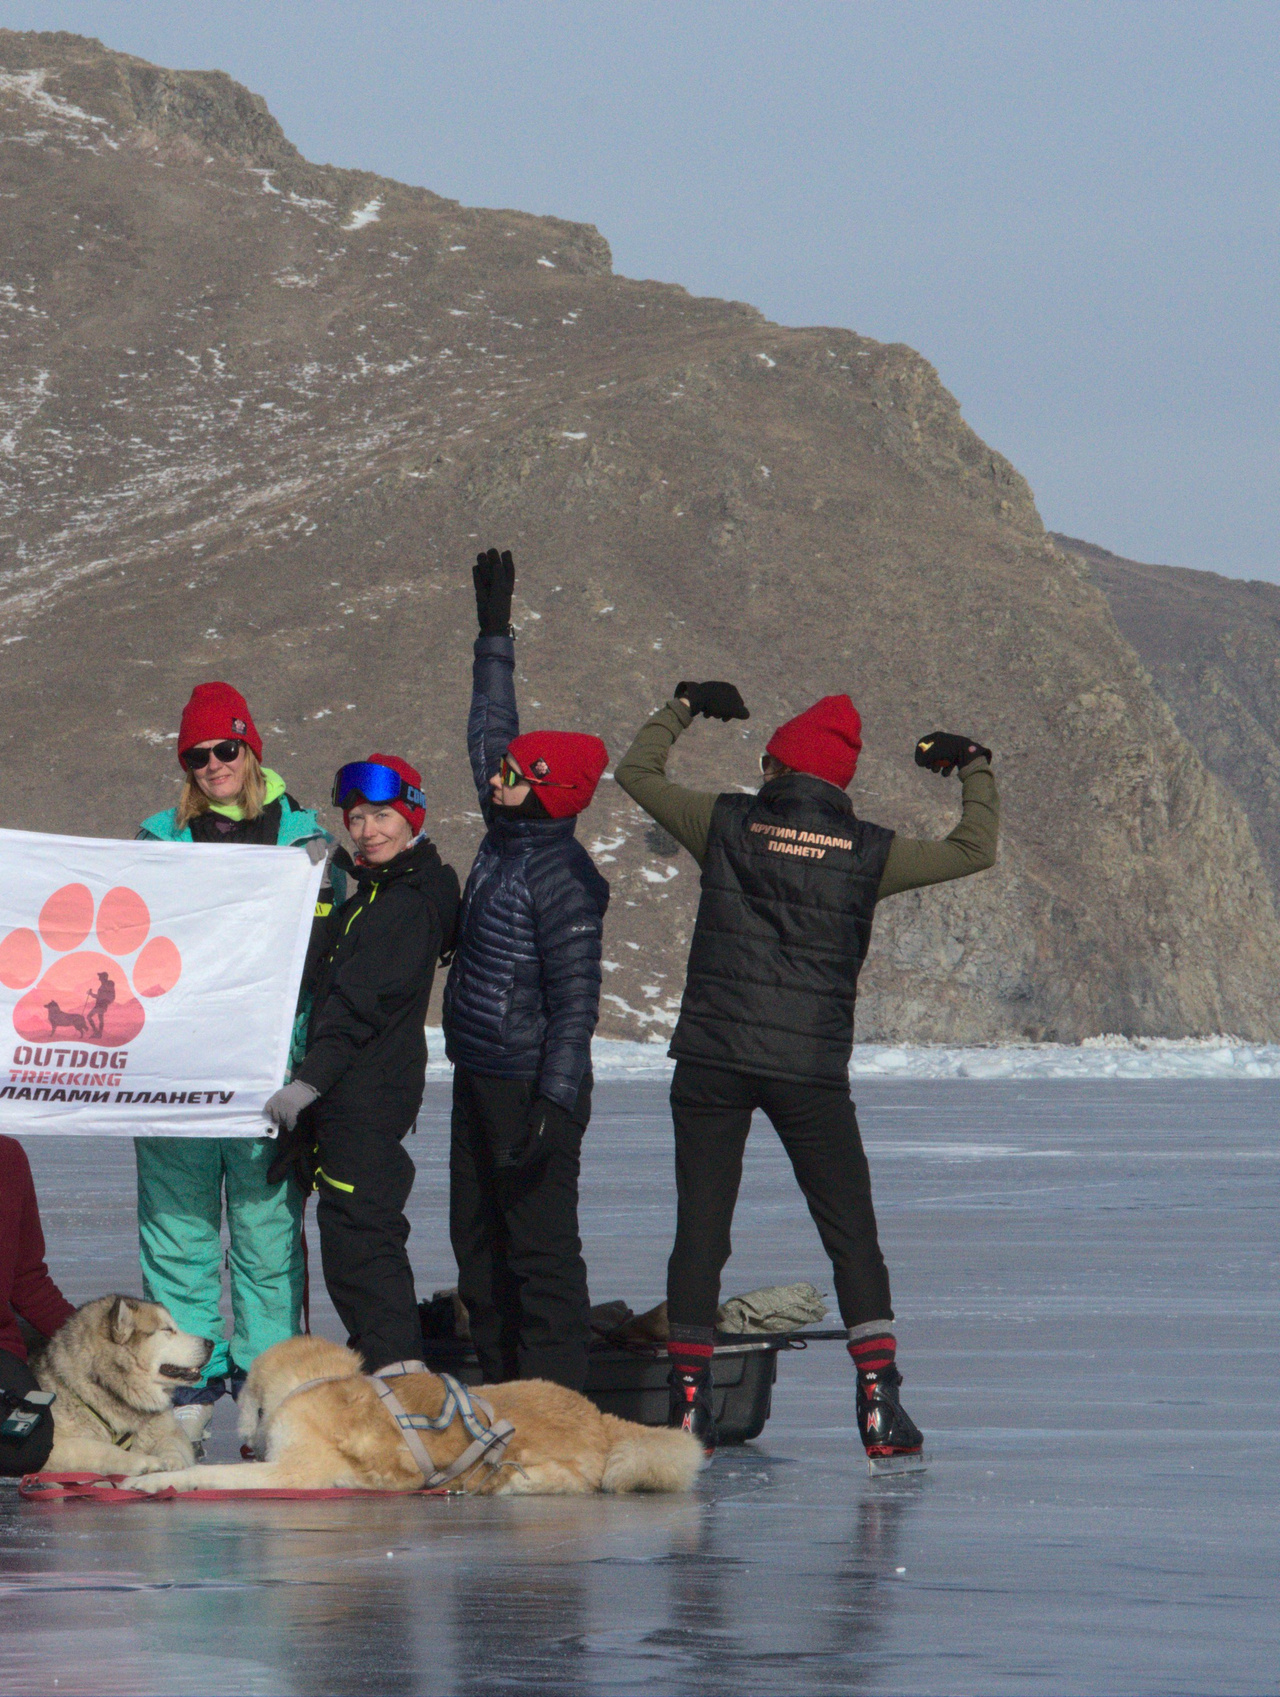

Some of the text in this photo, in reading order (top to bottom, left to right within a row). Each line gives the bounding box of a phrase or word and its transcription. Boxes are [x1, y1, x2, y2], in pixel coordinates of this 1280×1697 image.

[750, 823, 853, 851] КРУТИМ ЛАПАМИ
[768, 840, 826, 859] ПЛАНЕТУ
[13, 1045, 128, 1069] OUTDOG
[9, 1069, 122, 1087] TREKKING
[115, 1091, 235, 1105] ПЛАНЕТУ
